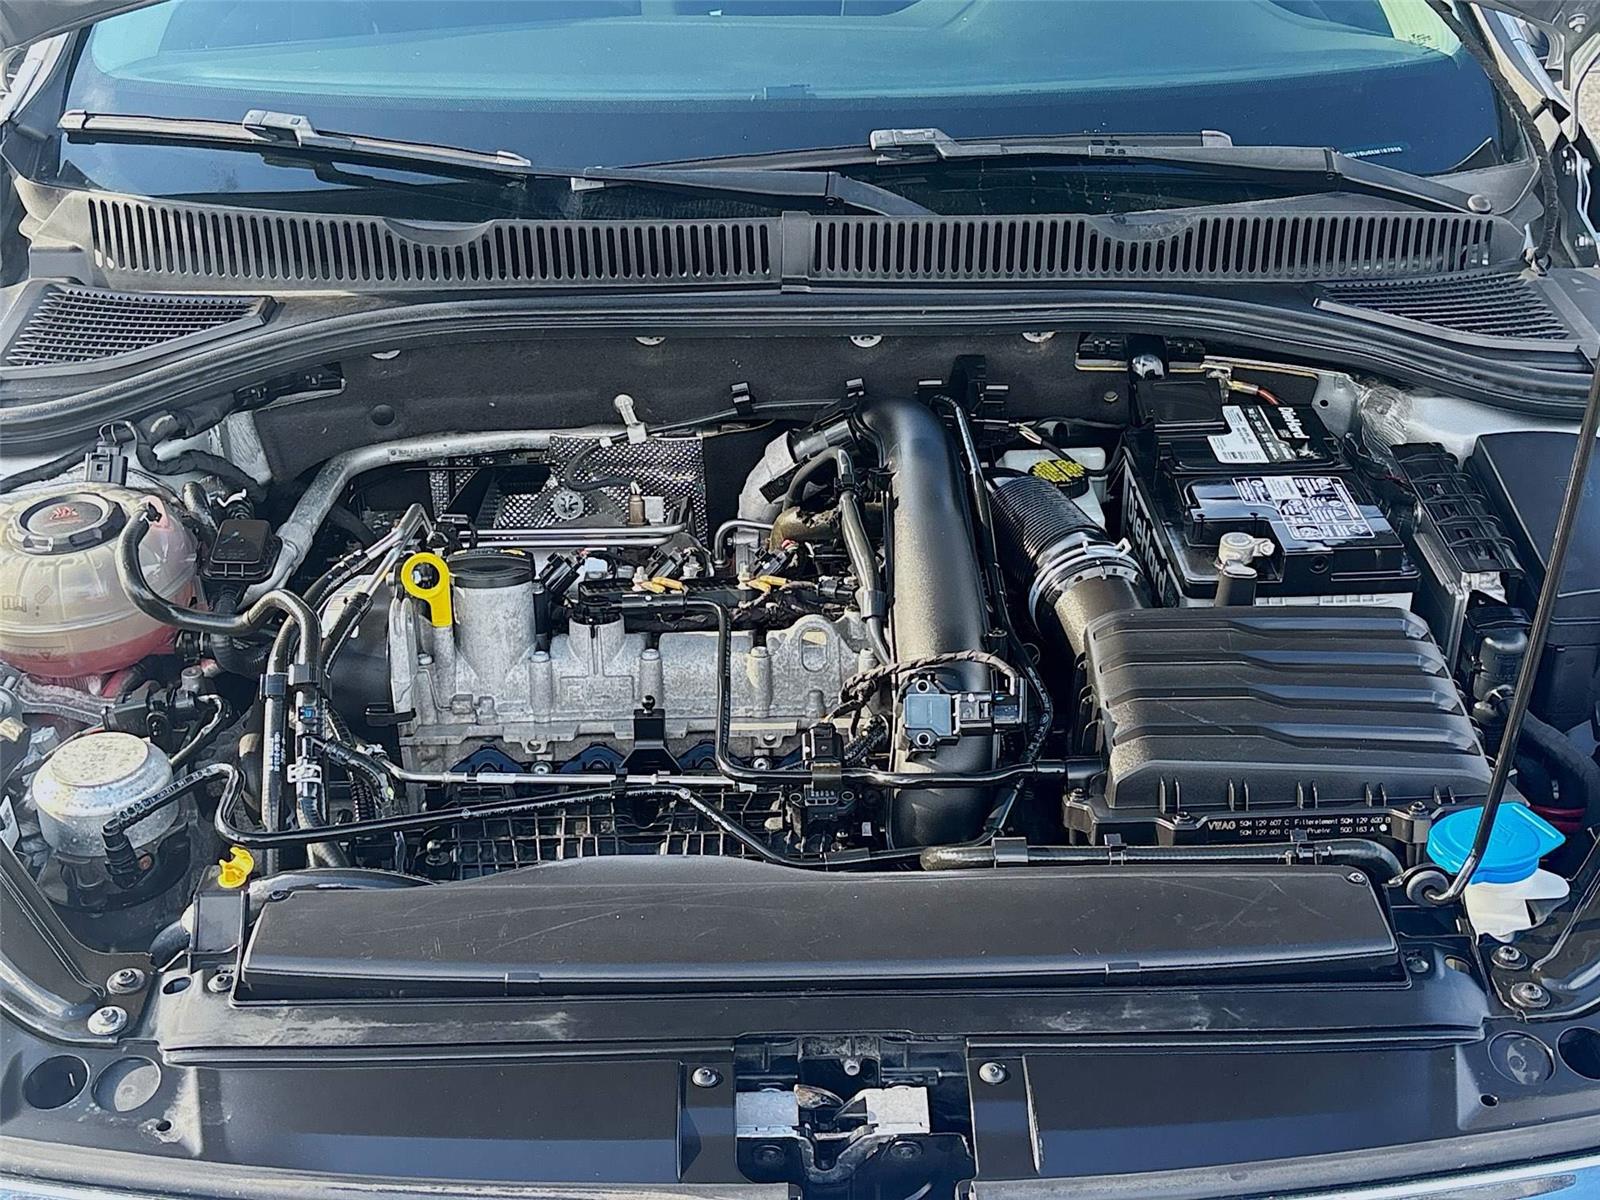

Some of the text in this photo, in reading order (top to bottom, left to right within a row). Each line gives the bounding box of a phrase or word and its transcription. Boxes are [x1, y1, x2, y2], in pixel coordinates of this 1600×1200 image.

[1278, 407, 1310, 439] DieHard
[1128, 486, 1166, 602] DieHard
[1255, 819, 1267, 827] 129
